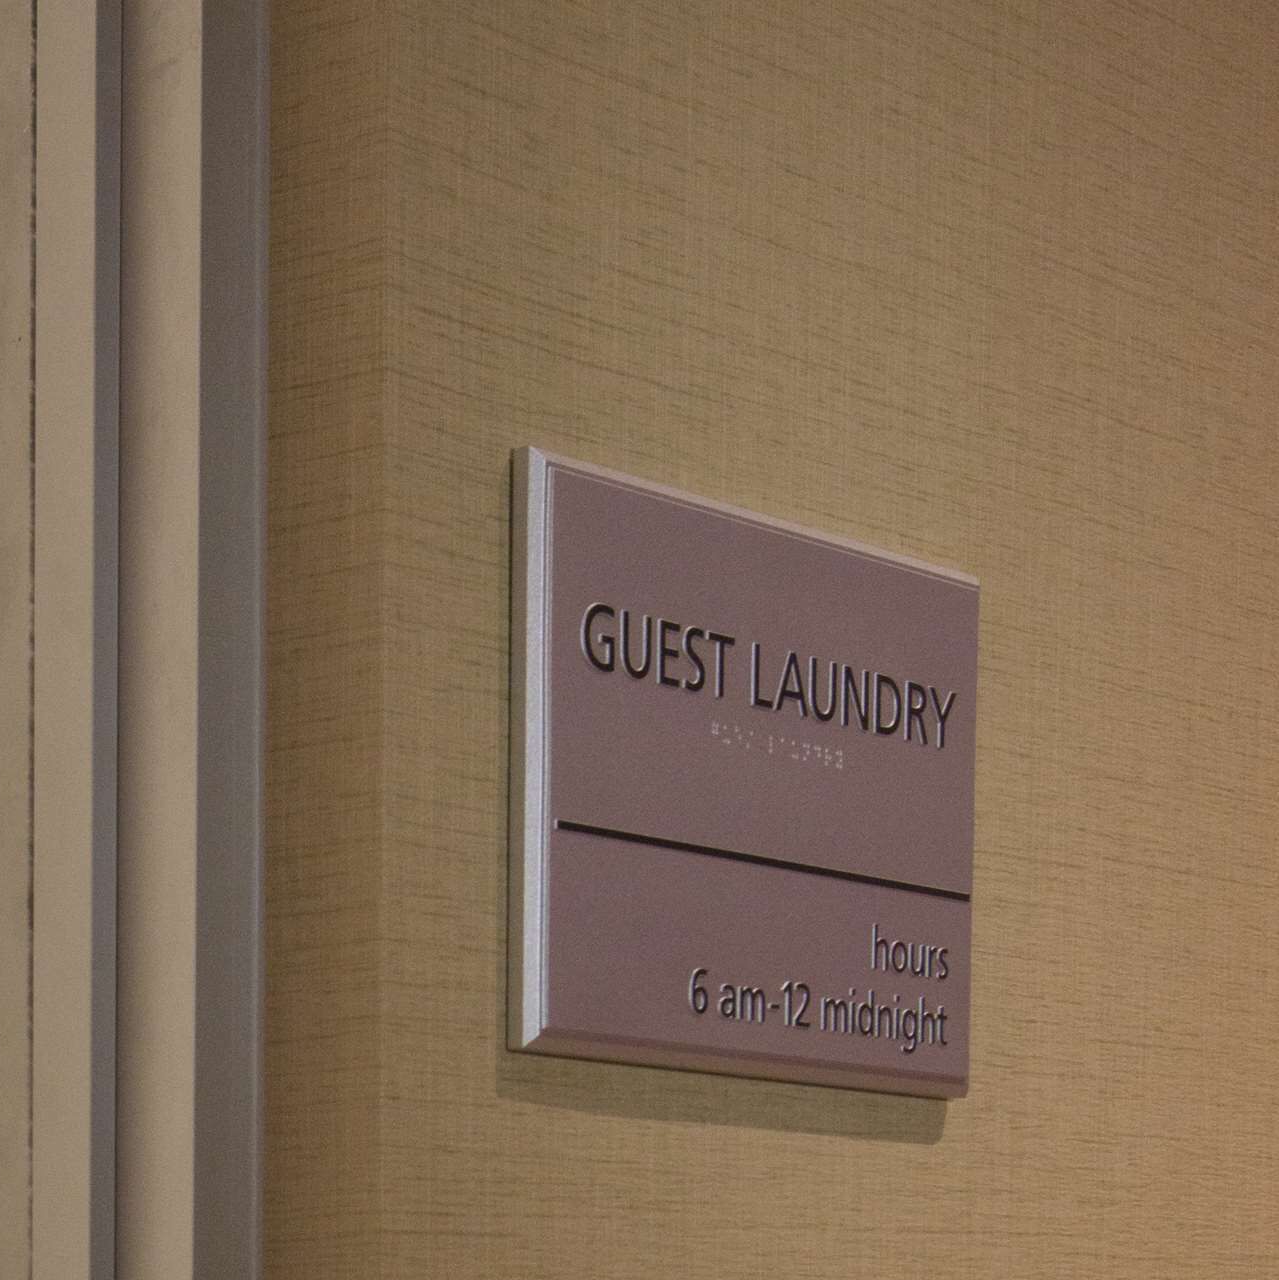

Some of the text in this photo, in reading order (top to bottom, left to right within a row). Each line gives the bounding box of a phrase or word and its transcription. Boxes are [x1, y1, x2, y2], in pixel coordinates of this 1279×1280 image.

[580, 602, 735, 699] GUEST
[750, 641, 957, 749] LAUNDRY
[871, 923, 949, 980] hours
[689, 967, 948, 1053] 6 am-12 midnight
